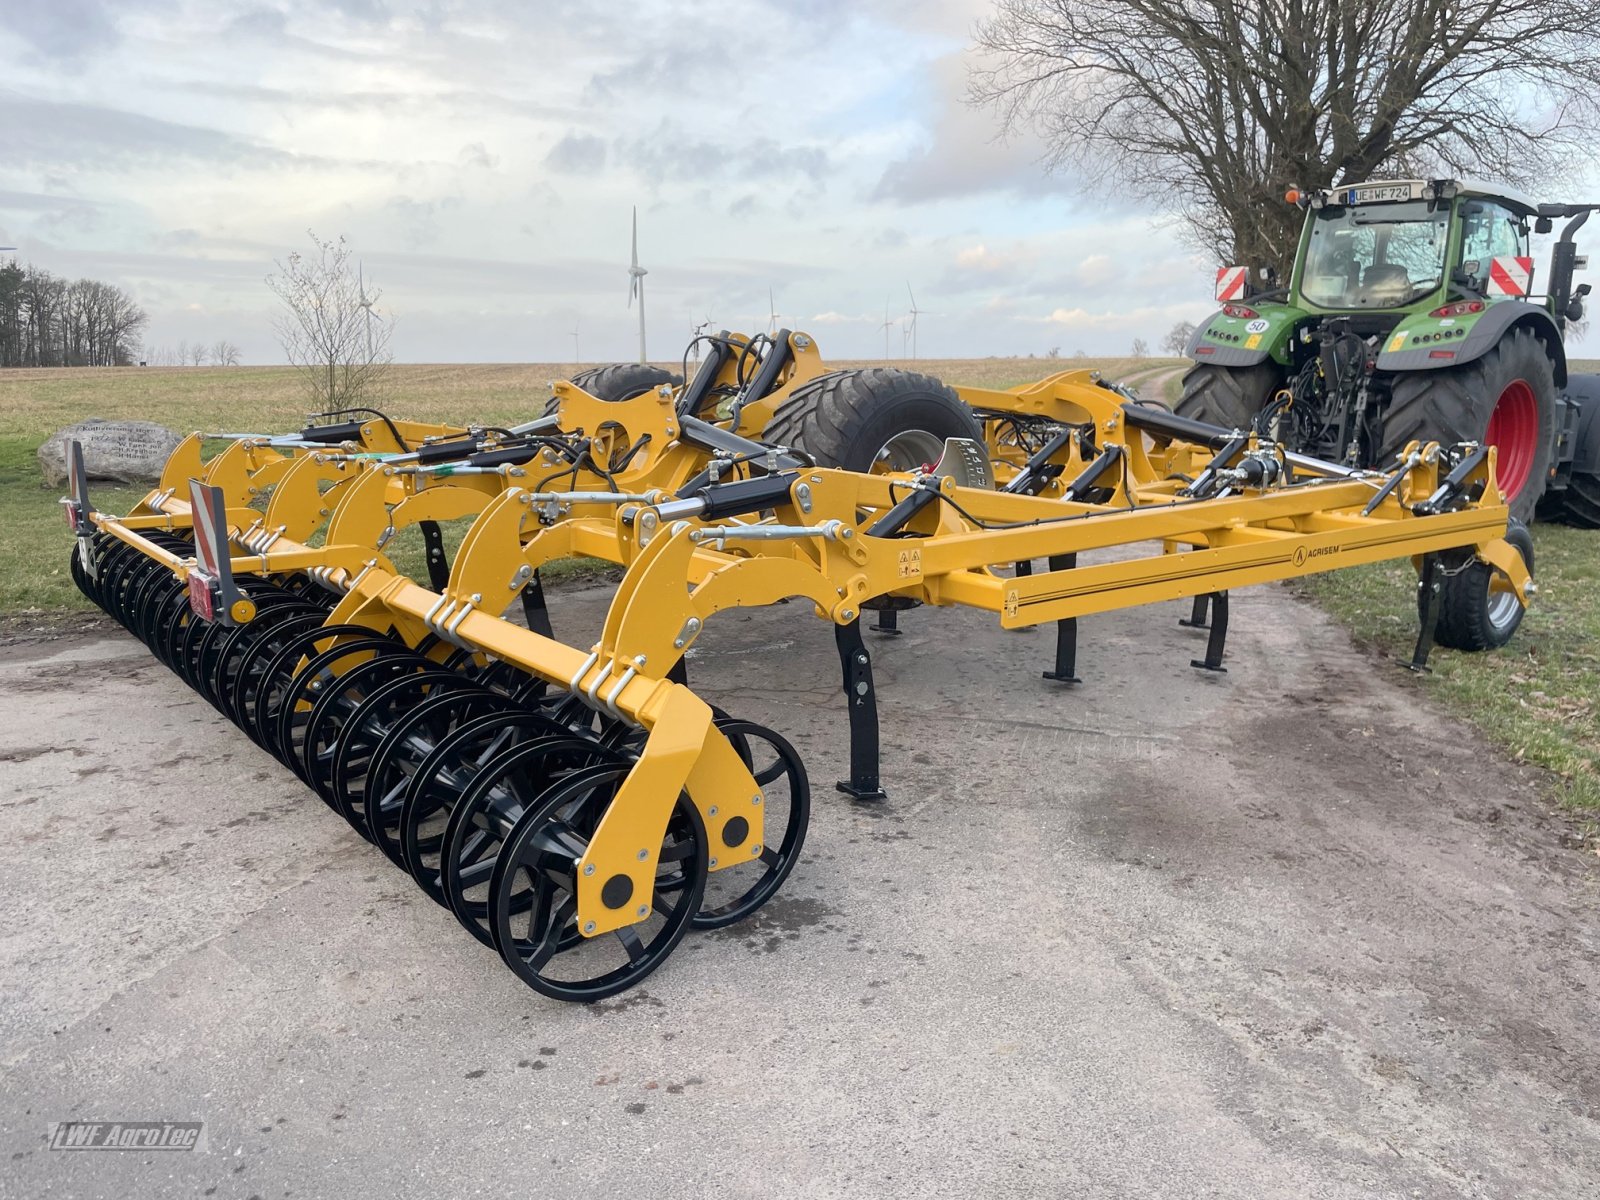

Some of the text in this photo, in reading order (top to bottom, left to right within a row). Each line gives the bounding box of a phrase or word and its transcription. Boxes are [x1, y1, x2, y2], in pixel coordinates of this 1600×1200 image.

[1355, 187, 1409, 201] UE WF 724
[1249, 321, 1266, 331] 50
[1307, 545, 1340, 559] AGRISEM
